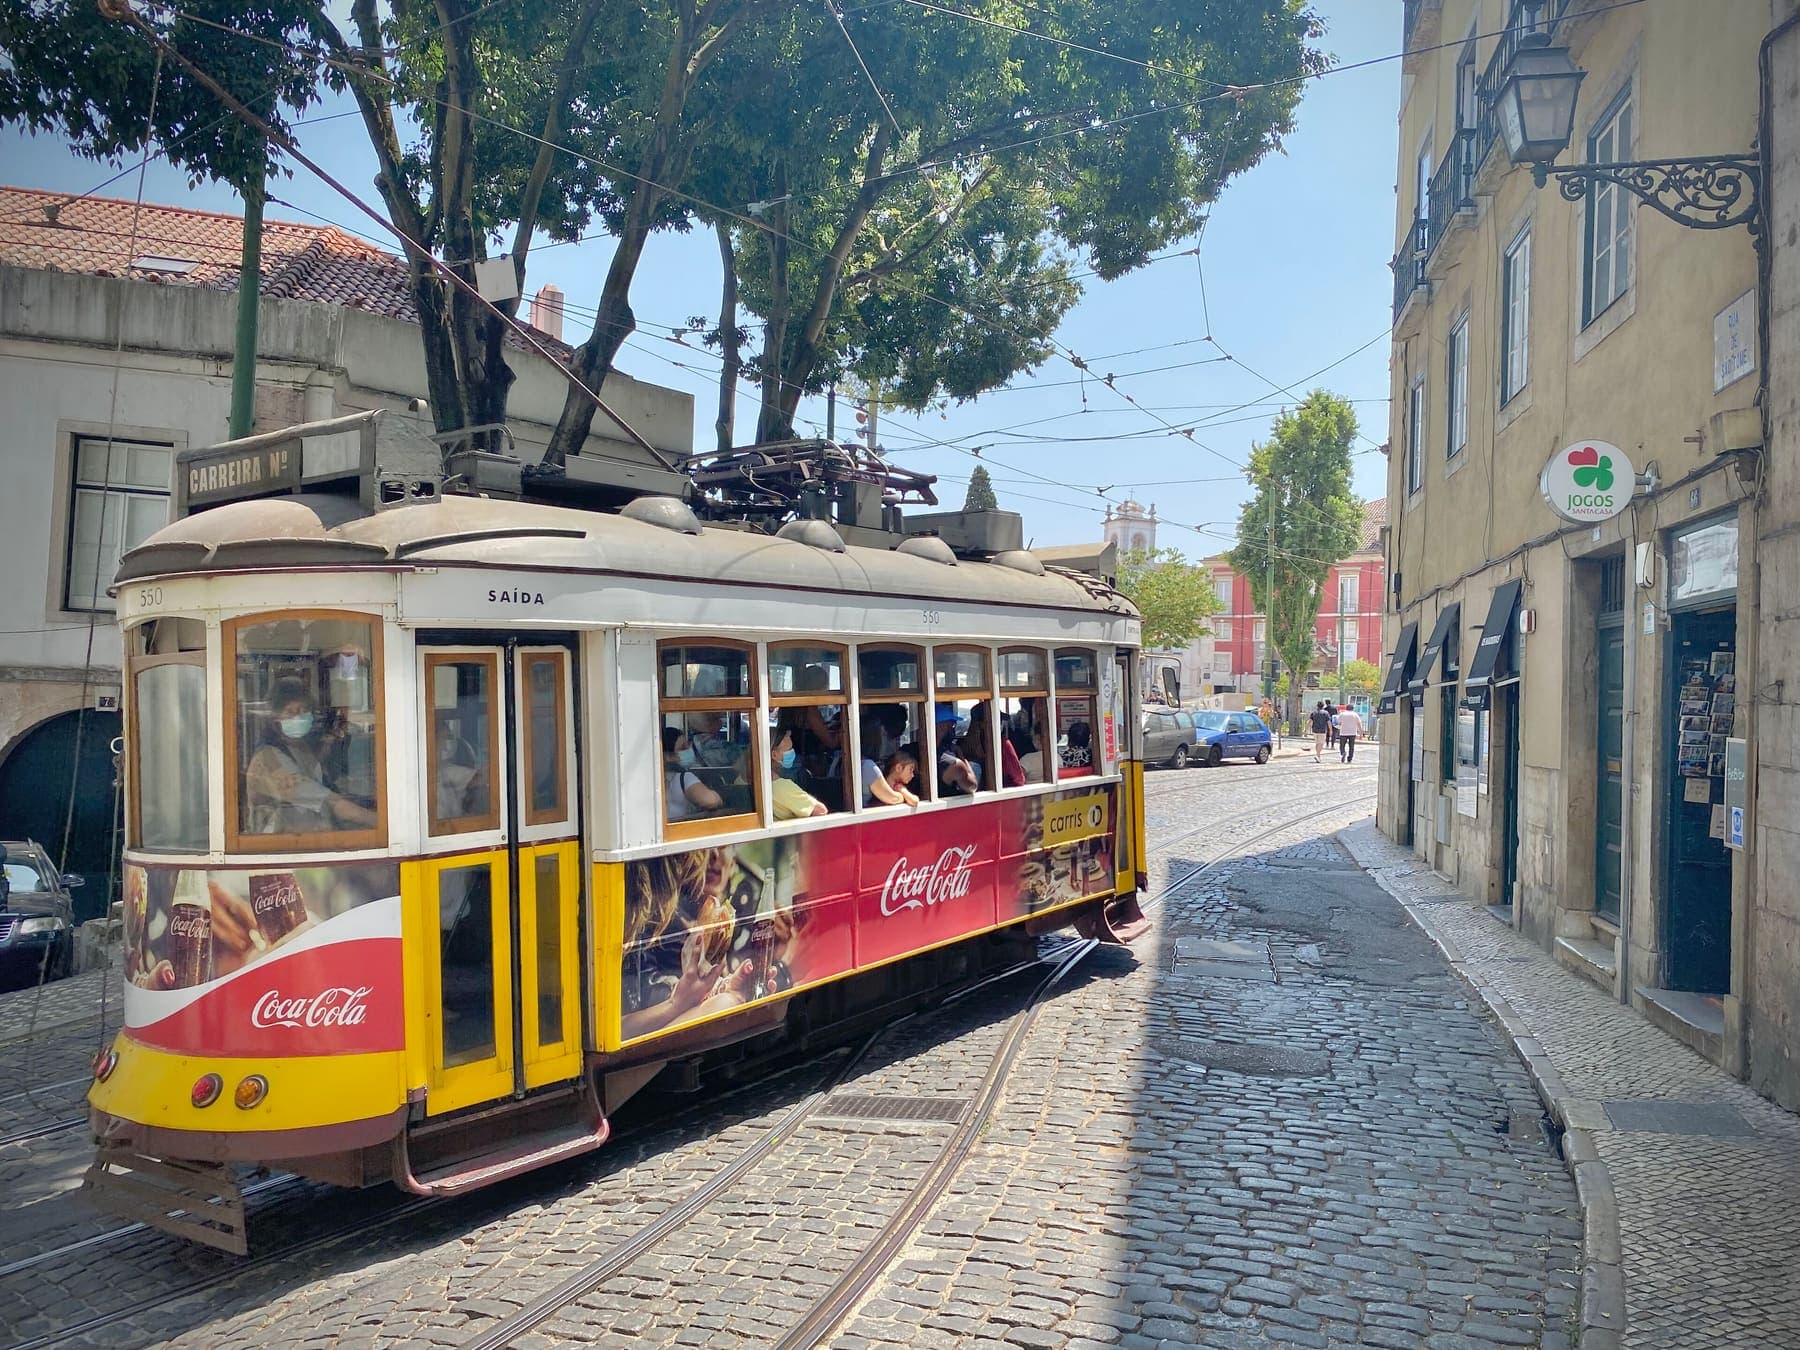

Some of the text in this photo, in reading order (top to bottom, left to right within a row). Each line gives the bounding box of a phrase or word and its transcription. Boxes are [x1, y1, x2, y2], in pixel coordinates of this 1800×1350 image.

[189, 456, 262, 494] CARREIRA
[1568, 494, 1614, 510] JOGOS
[140, 587, 163, 607] 550
[488, 587, 544, 605] SAÍDA
[922, 610, 940, 625] 550
[1050, 807, 1083, 833] carris
[881, 843, 978, 917] Coca-Cola
[255, 887, 298, 915] Coca-Cola
[170, 915, 211, 939] Coca-Cola
[251, 986, 374, 1029] Coca-Cola
